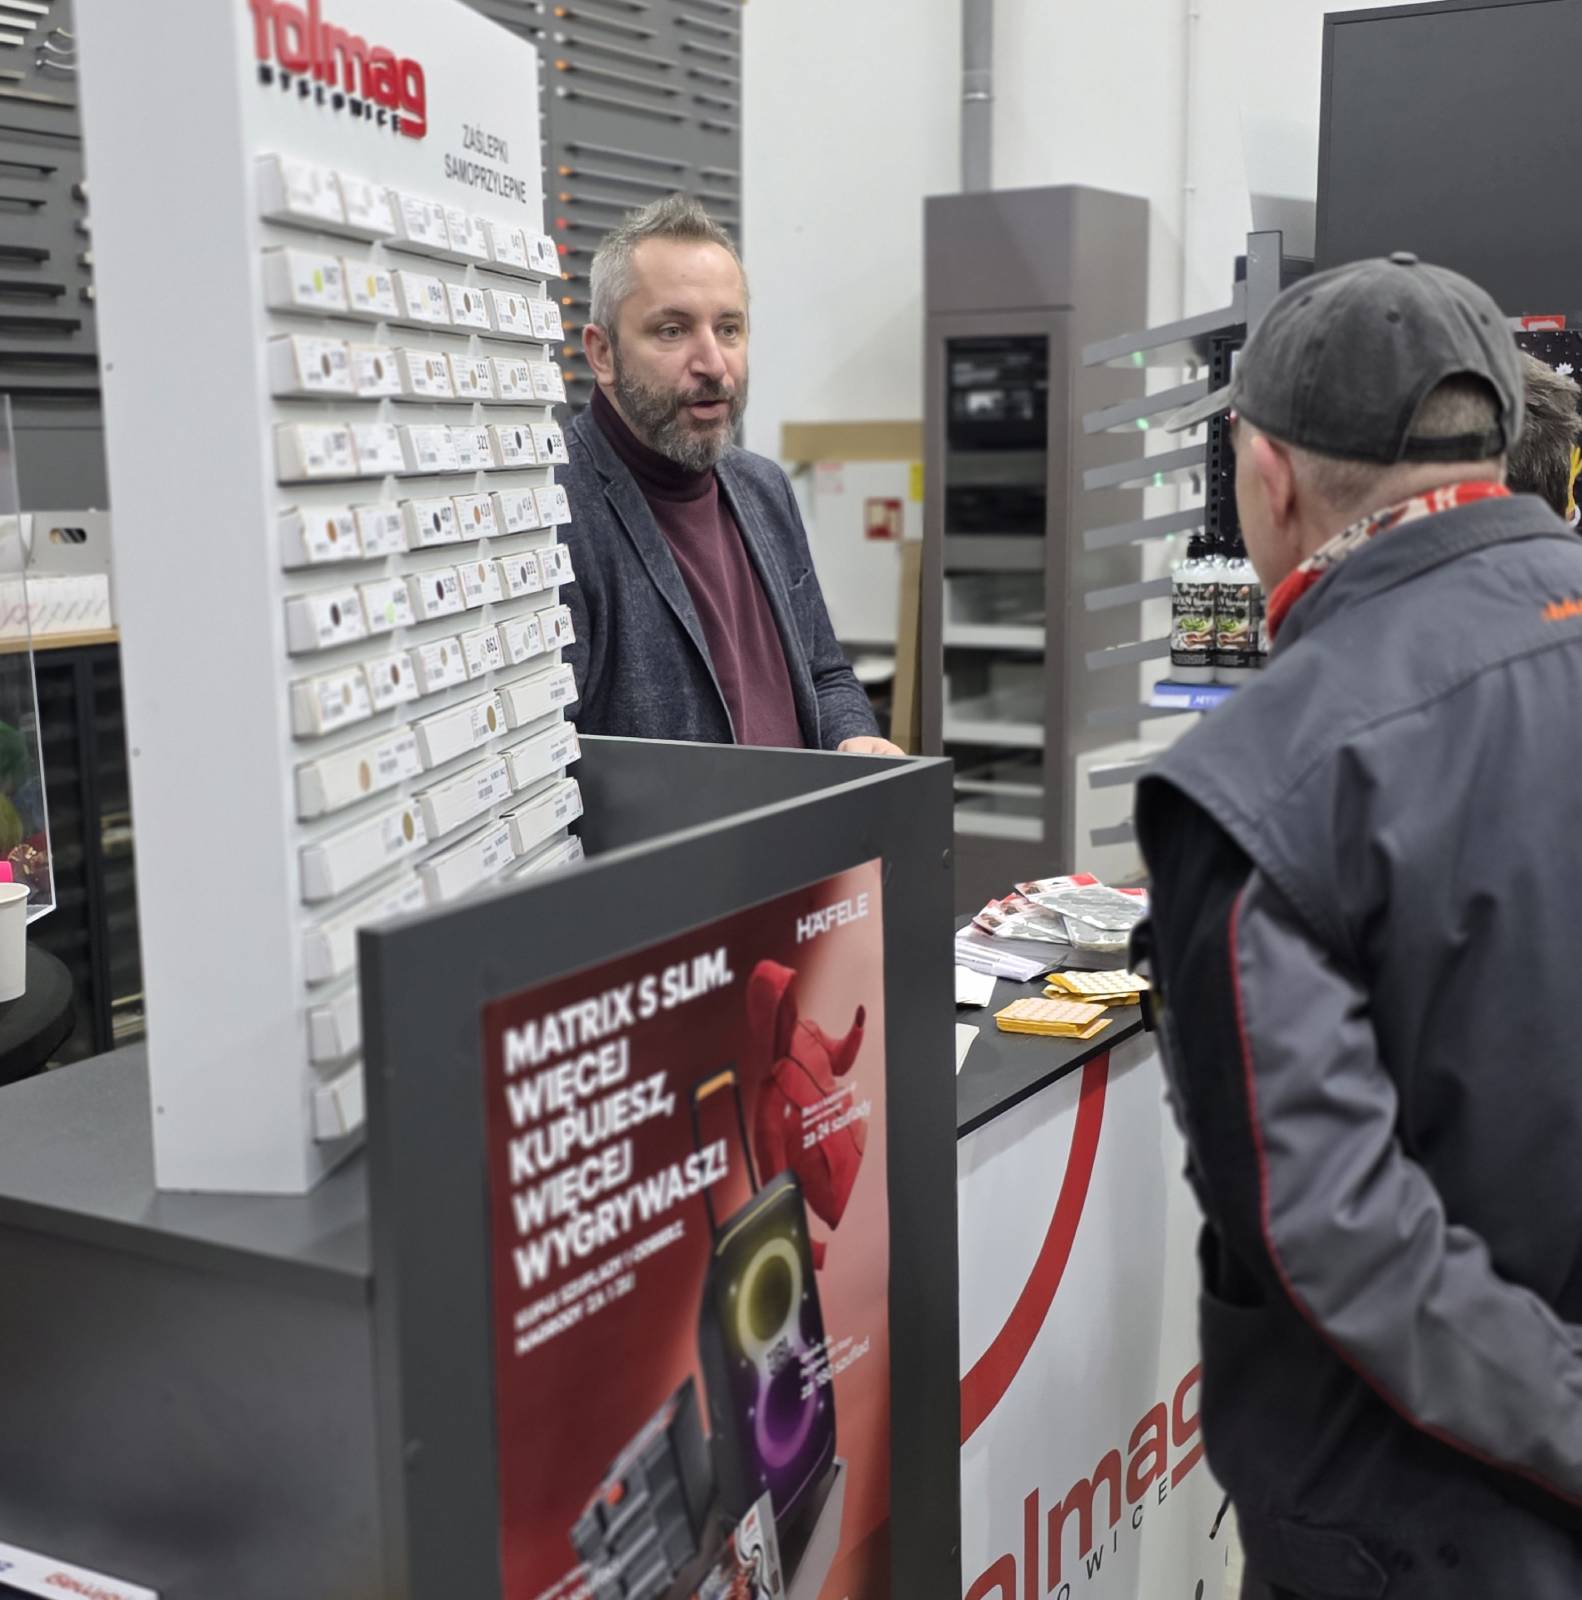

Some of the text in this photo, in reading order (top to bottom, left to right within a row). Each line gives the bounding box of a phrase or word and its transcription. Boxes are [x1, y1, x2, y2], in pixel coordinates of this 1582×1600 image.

[444, 152, 526, 204] SAMOPRZYLEPNE
[462, 123, 508, 164] ZAŚLEPKI
[503, 947, 735, 1076] MATRIX S SLIM.
[506, 1036, 630, 1128] WIĘCEJ
[510, 1071, 676, 1186] KUPUJESZ,
[514, 1138, 632, 1237] WIĘCEJ
[514, 1138, 729, 1290] WYGRYWASZ!
